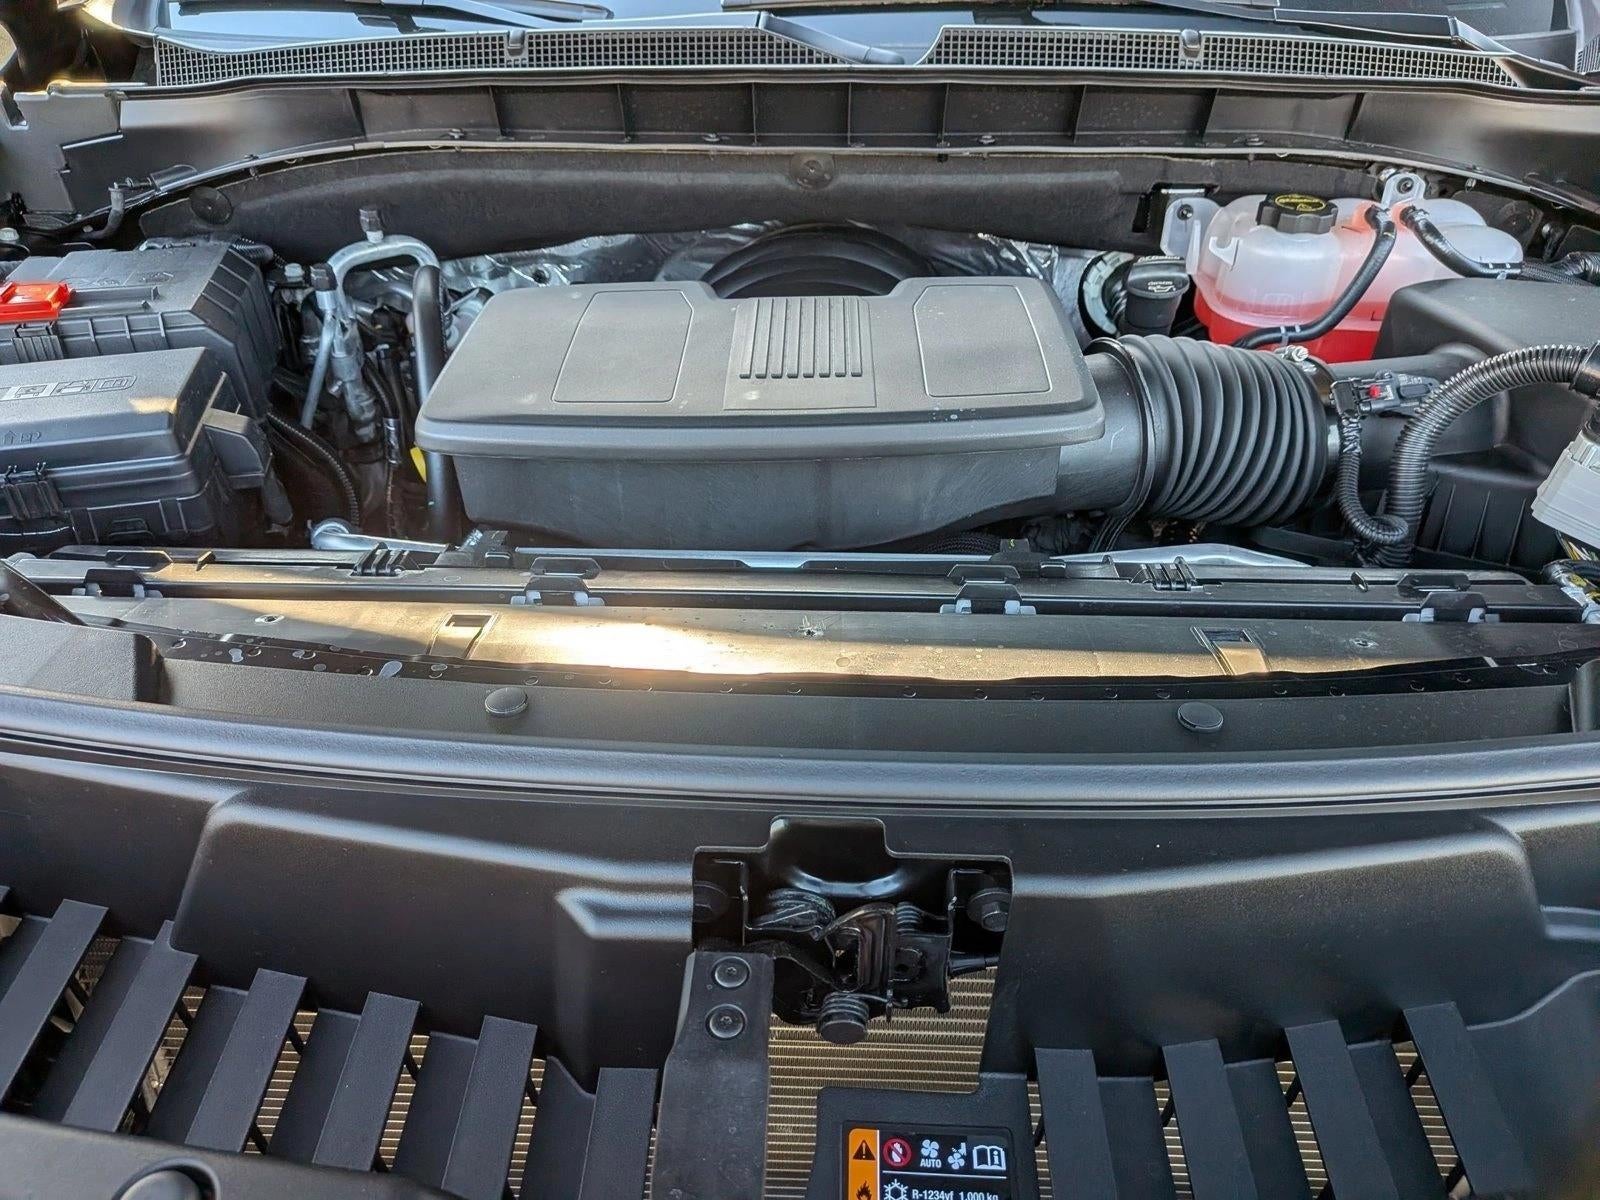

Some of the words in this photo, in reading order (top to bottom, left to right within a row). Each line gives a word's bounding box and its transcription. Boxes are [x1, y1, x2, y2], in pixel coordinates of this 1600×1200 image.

[920, 1158, 942, 1168] AUTO
[912, 1188, 954, 1200] R-1234yf
[986, 1192, 999, 1200] kg
